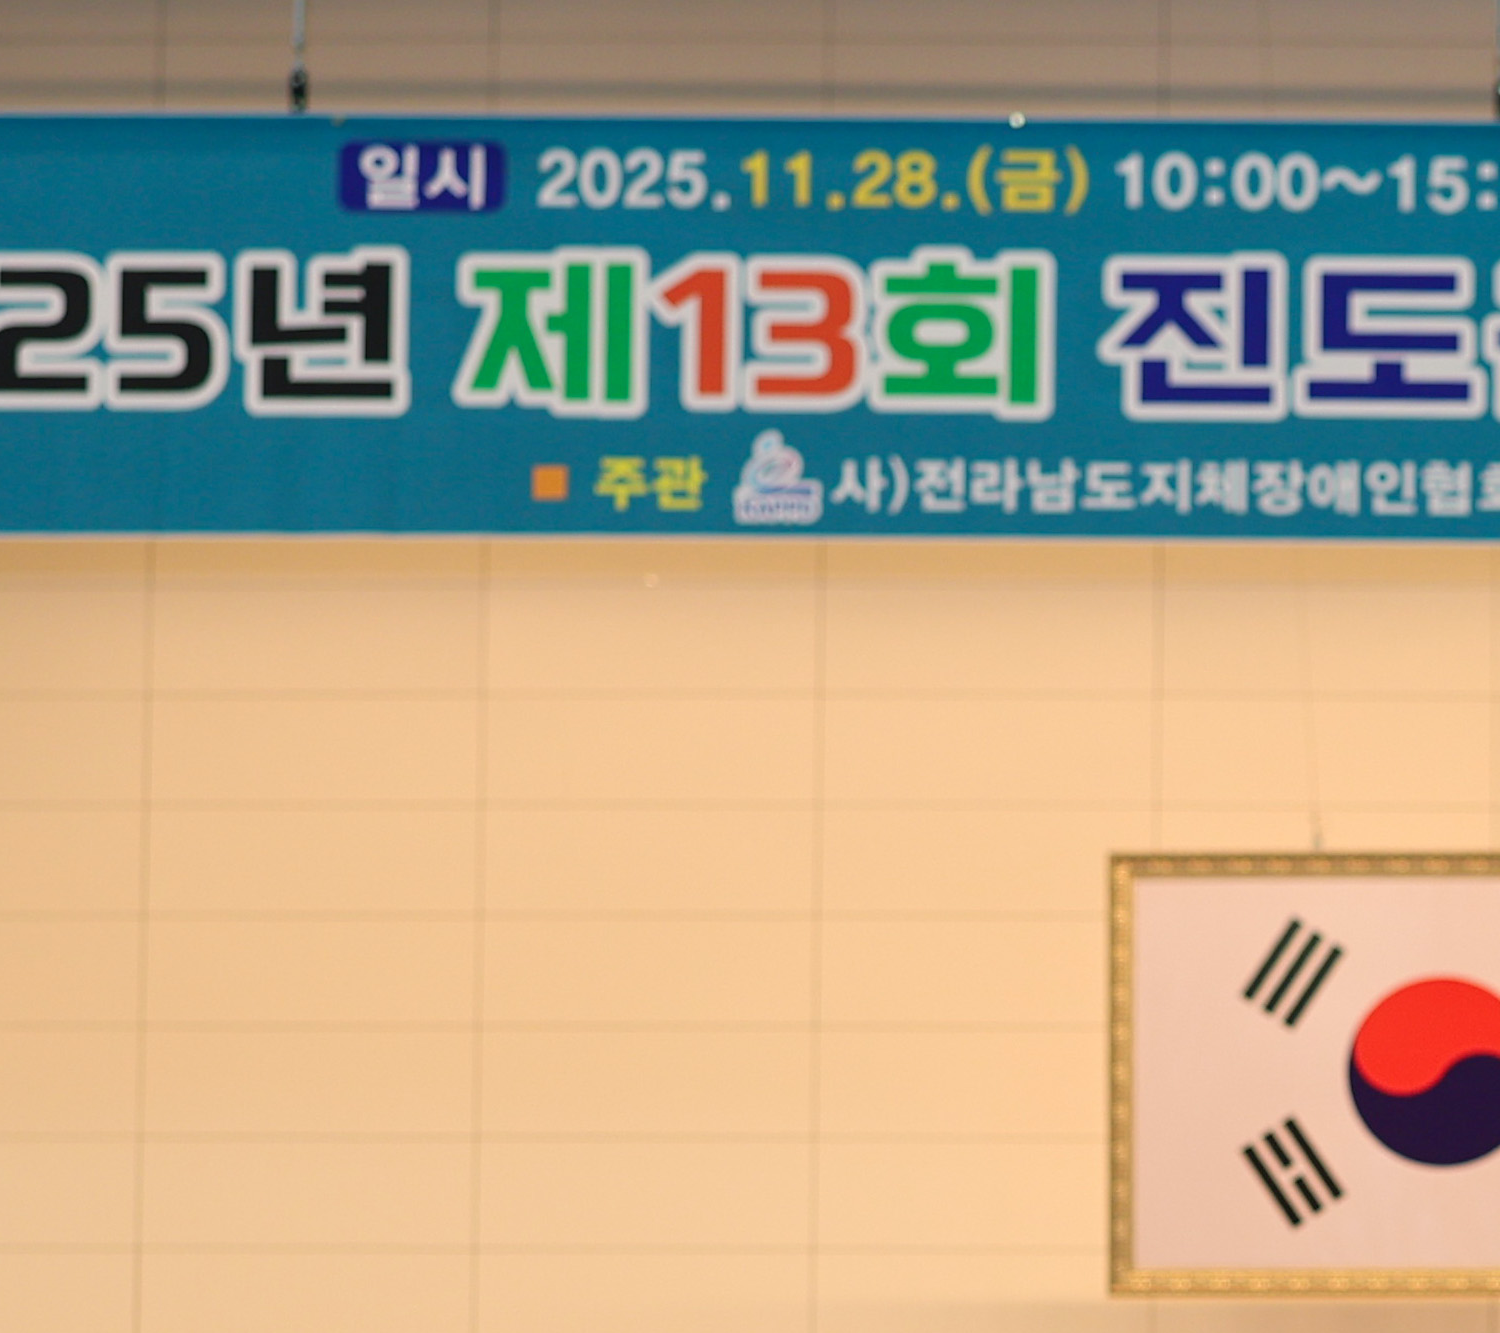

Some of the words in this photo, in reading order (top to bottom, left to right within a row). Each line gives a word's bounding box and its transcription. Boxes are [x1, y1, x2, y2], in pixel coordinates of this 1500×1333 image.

[358, 144, 489, 211] 일시
[457, 249, 1050, 416] 제13회
[594, 455, 707, 512] 주관
